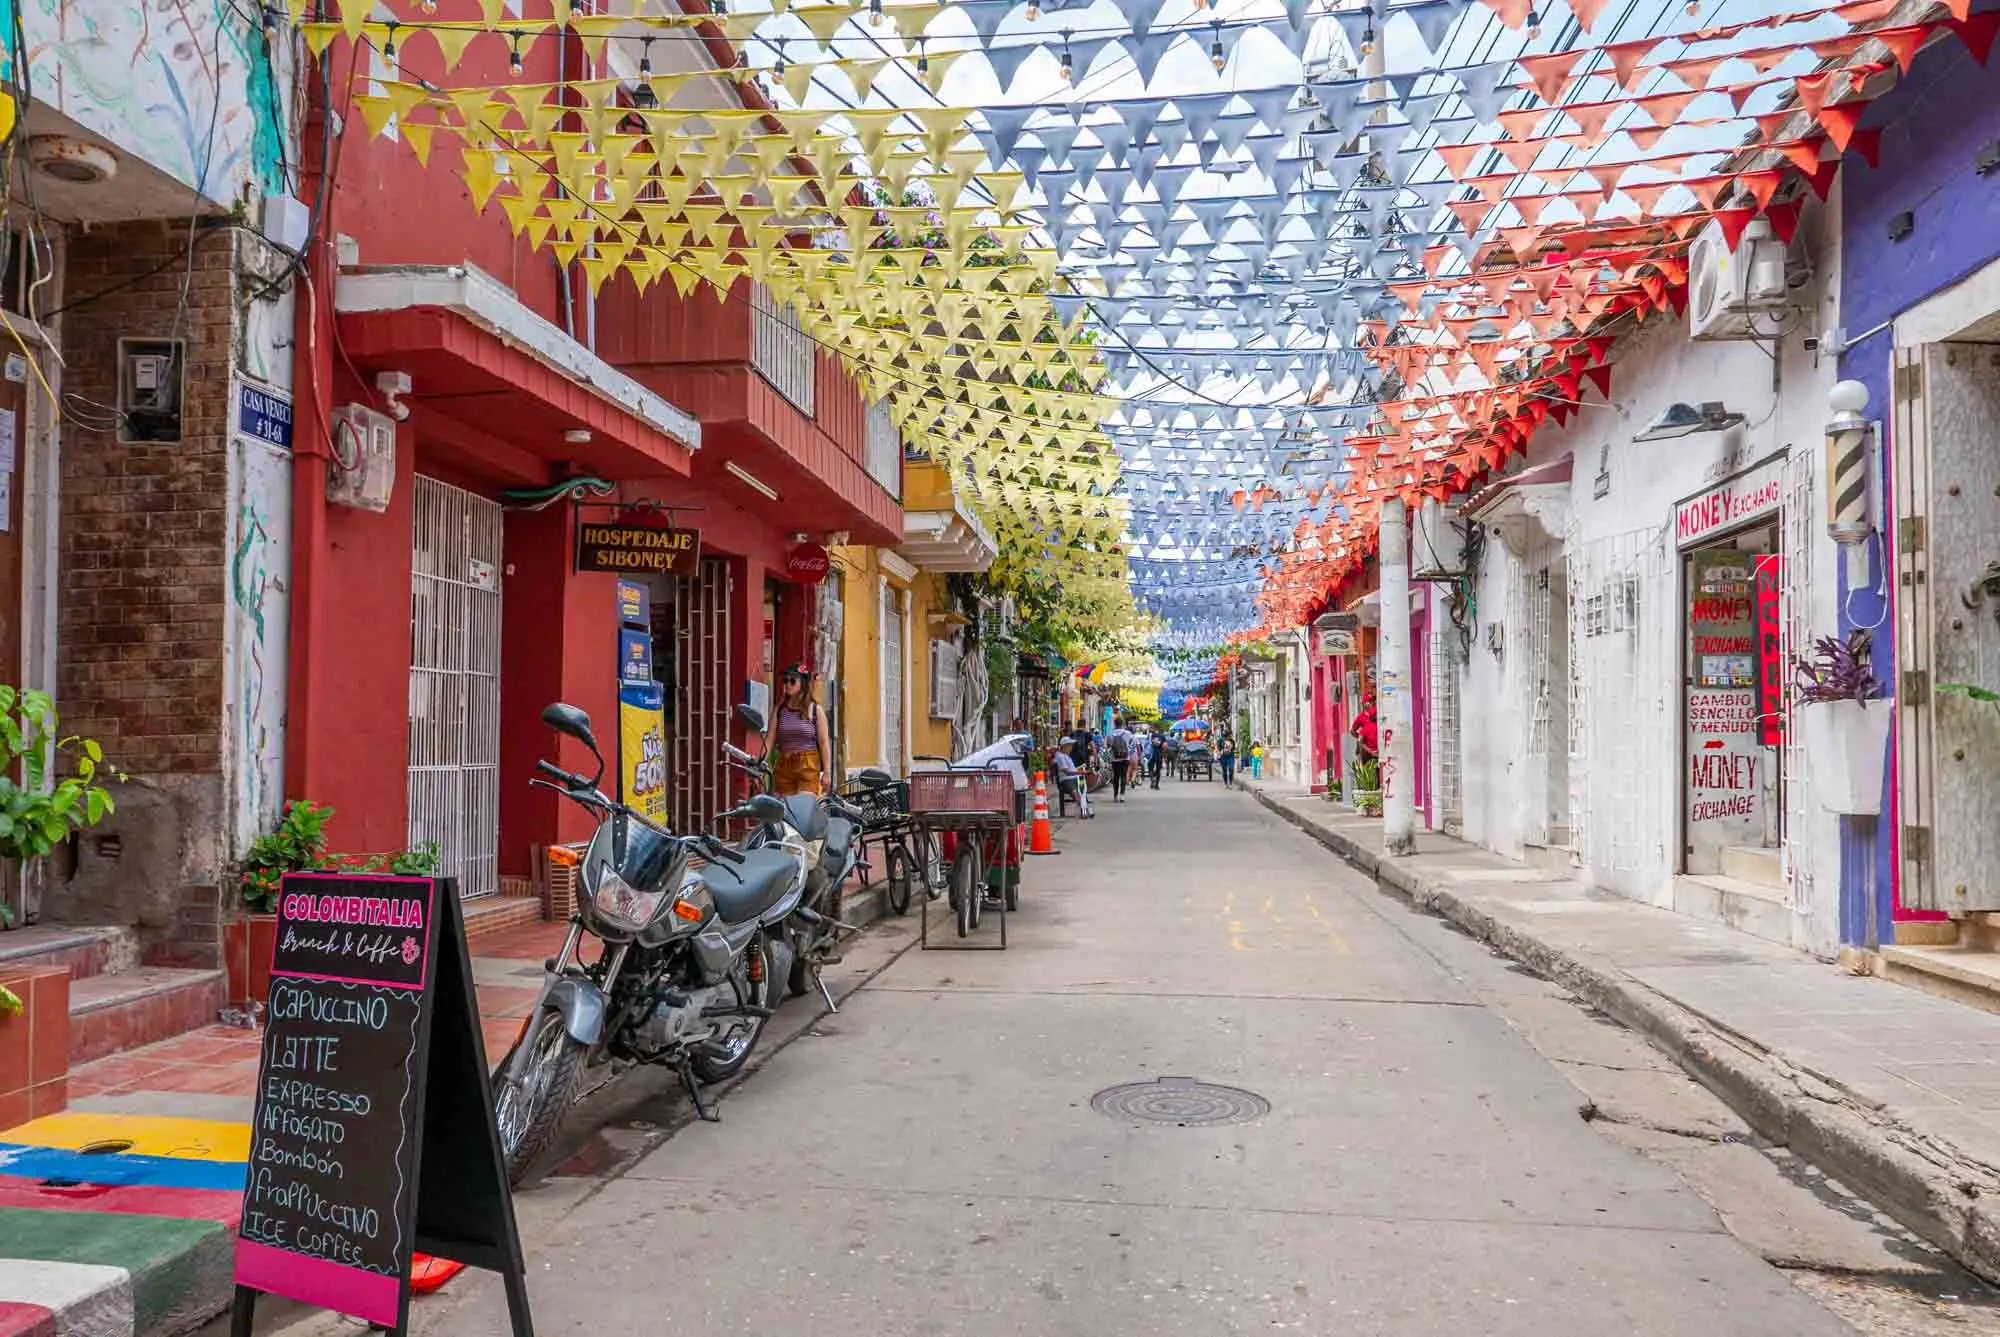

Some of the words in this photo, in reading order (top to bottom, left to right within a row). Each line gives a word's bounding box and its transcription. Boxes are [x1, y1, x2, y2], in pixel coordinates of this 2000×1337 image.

[243, 388, 264, 413] CASA
[1679, 487, 1732, 539] MONEY
[584, 528, 693, 550] HOSPEDAJE
[596, 550, 677, 569] SIBONEY
[1690, 694, 1751, 706] CAMBIO
[1690, 707, 1757, 720] SENCILLO
[1692, 752, 1756, 789] MONEY
[1692, 795, 1755, 821] EXCHANGE
[284, 893, 423, 928] COLOMBITALIA
[280, 925, 340, 955] Brunch
[341, 931, 355, 956] &
[267, 1076, 371, 1115] EXPRESSO
[248, 1211, 288, 1244] ICE
